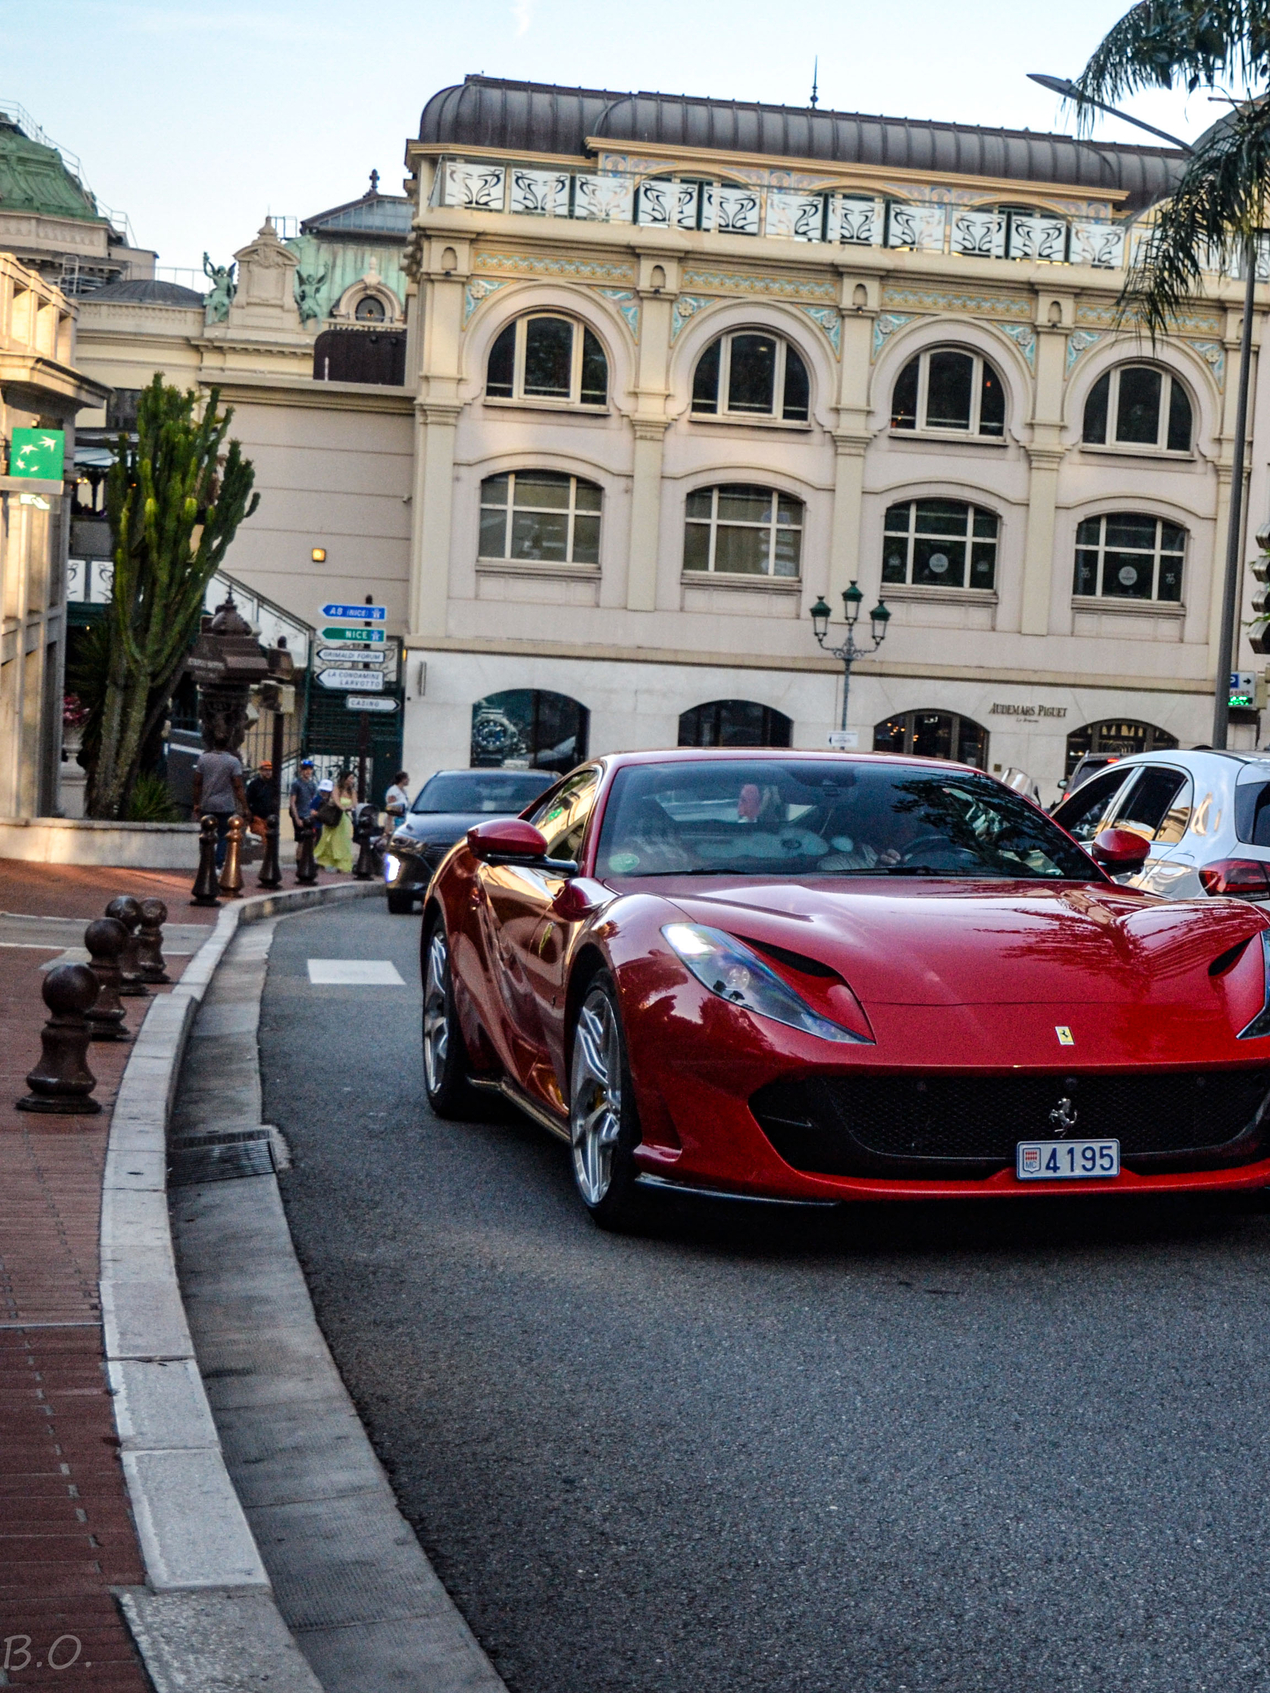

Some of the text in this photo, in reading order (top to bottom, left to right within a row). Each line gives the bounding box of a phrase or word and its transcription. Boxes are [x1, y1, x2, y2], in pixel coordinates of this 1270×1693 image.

[329, 607, 343, 615] A8
[345, 630, 368, 639] NICE
[323, 651, 381, 660] GRIMALDI FORUM
[338, 672, 380, 680] CONDAMINE
[339, 680, 381, 688] LARVOTTO
[350, 700, 380, 708] CASINO
[988, 702, 1068, 717] AUDEMARS PIGUET
[1045, 1145, 1114, 1174] 4195
[1025, 1160, 1037, 1170] MC
